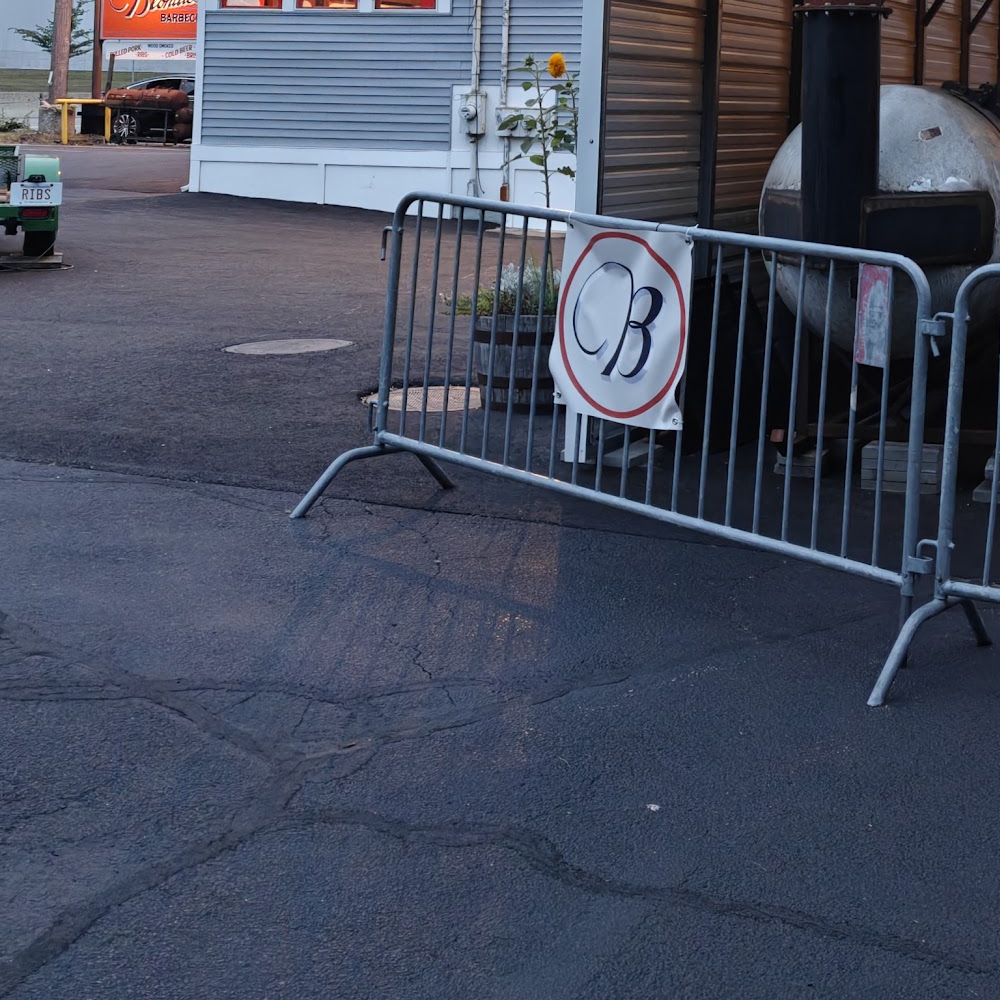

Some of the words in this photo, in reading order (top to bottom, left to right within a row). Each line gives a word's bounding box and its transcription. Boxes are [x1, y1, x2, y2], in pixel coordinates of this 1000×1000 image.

[160, 13, 197, 23] BARBEC
[128, 44, 141, 53] PORK
[165, 49, 179, 58] COLD
[180, 45, 193, 54] BEER
[22, 188, 51, 200] RIBS
